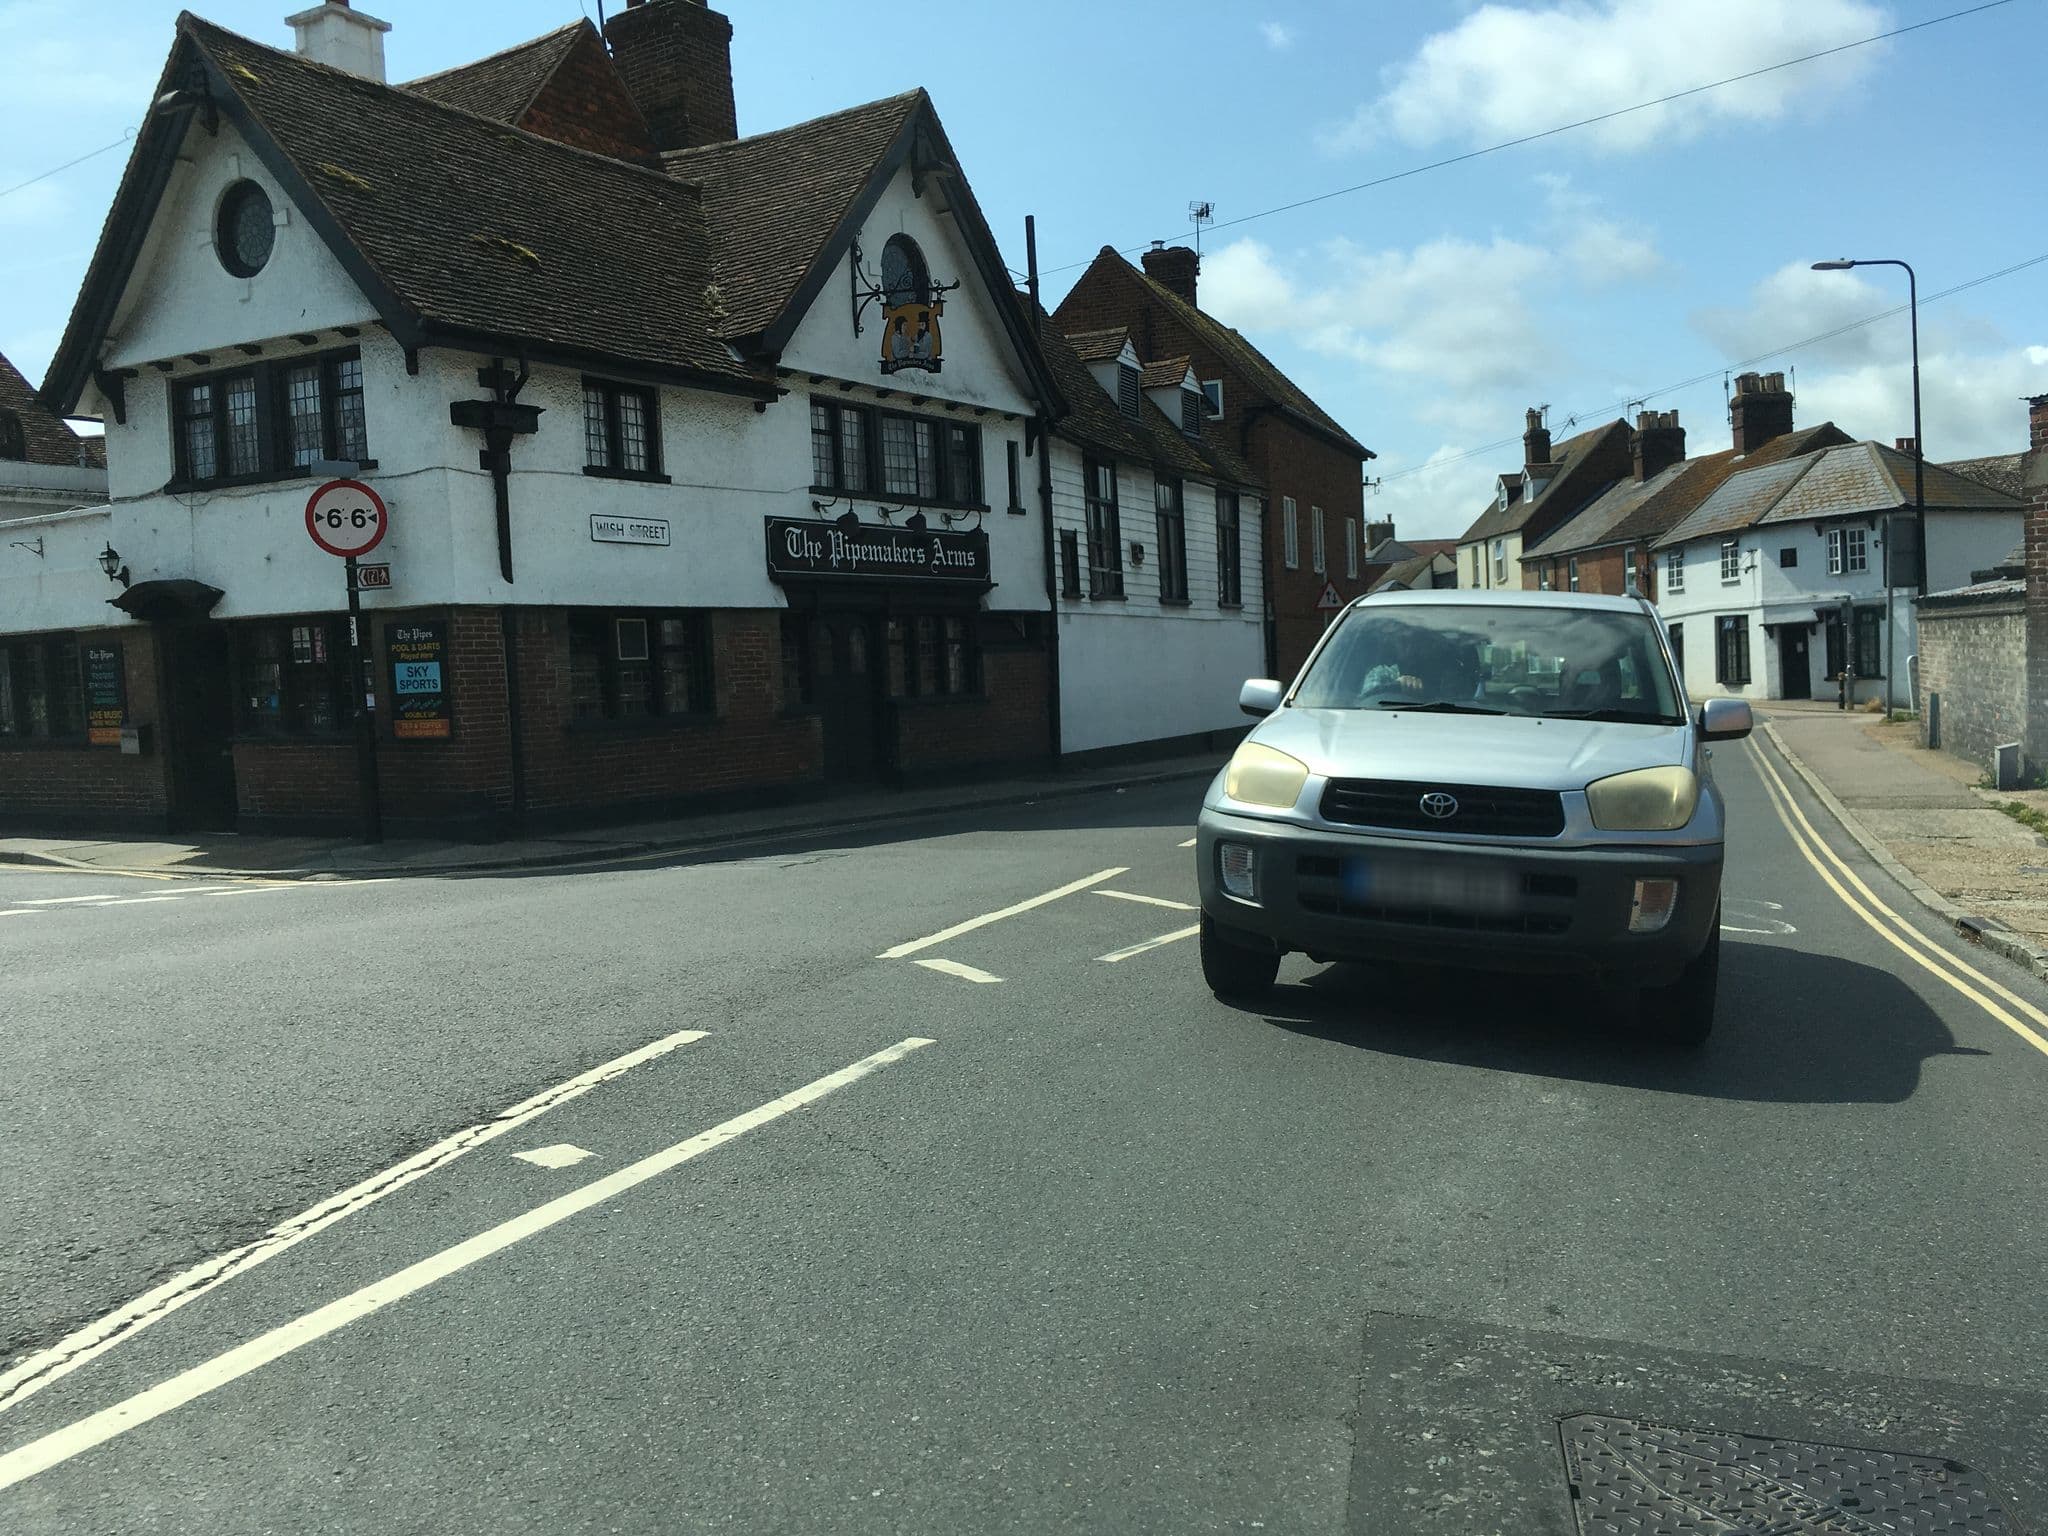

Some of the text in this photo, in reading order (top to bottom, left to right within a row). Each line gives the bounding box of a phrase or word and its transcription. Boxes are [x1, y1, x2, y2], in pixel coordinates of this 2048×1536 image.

[595, 521, 666, 540] WISH STREET
[784, 526, 976, 574] The Pipemakers Arms
[396, 628, 433, 641] The Pipes
[391, 643, 411, 652] POOL
[417, 642, 441, 651] DARTS
[407, 666, 429, 678] SKY
[399, 679, 439, 690] SPORTS
